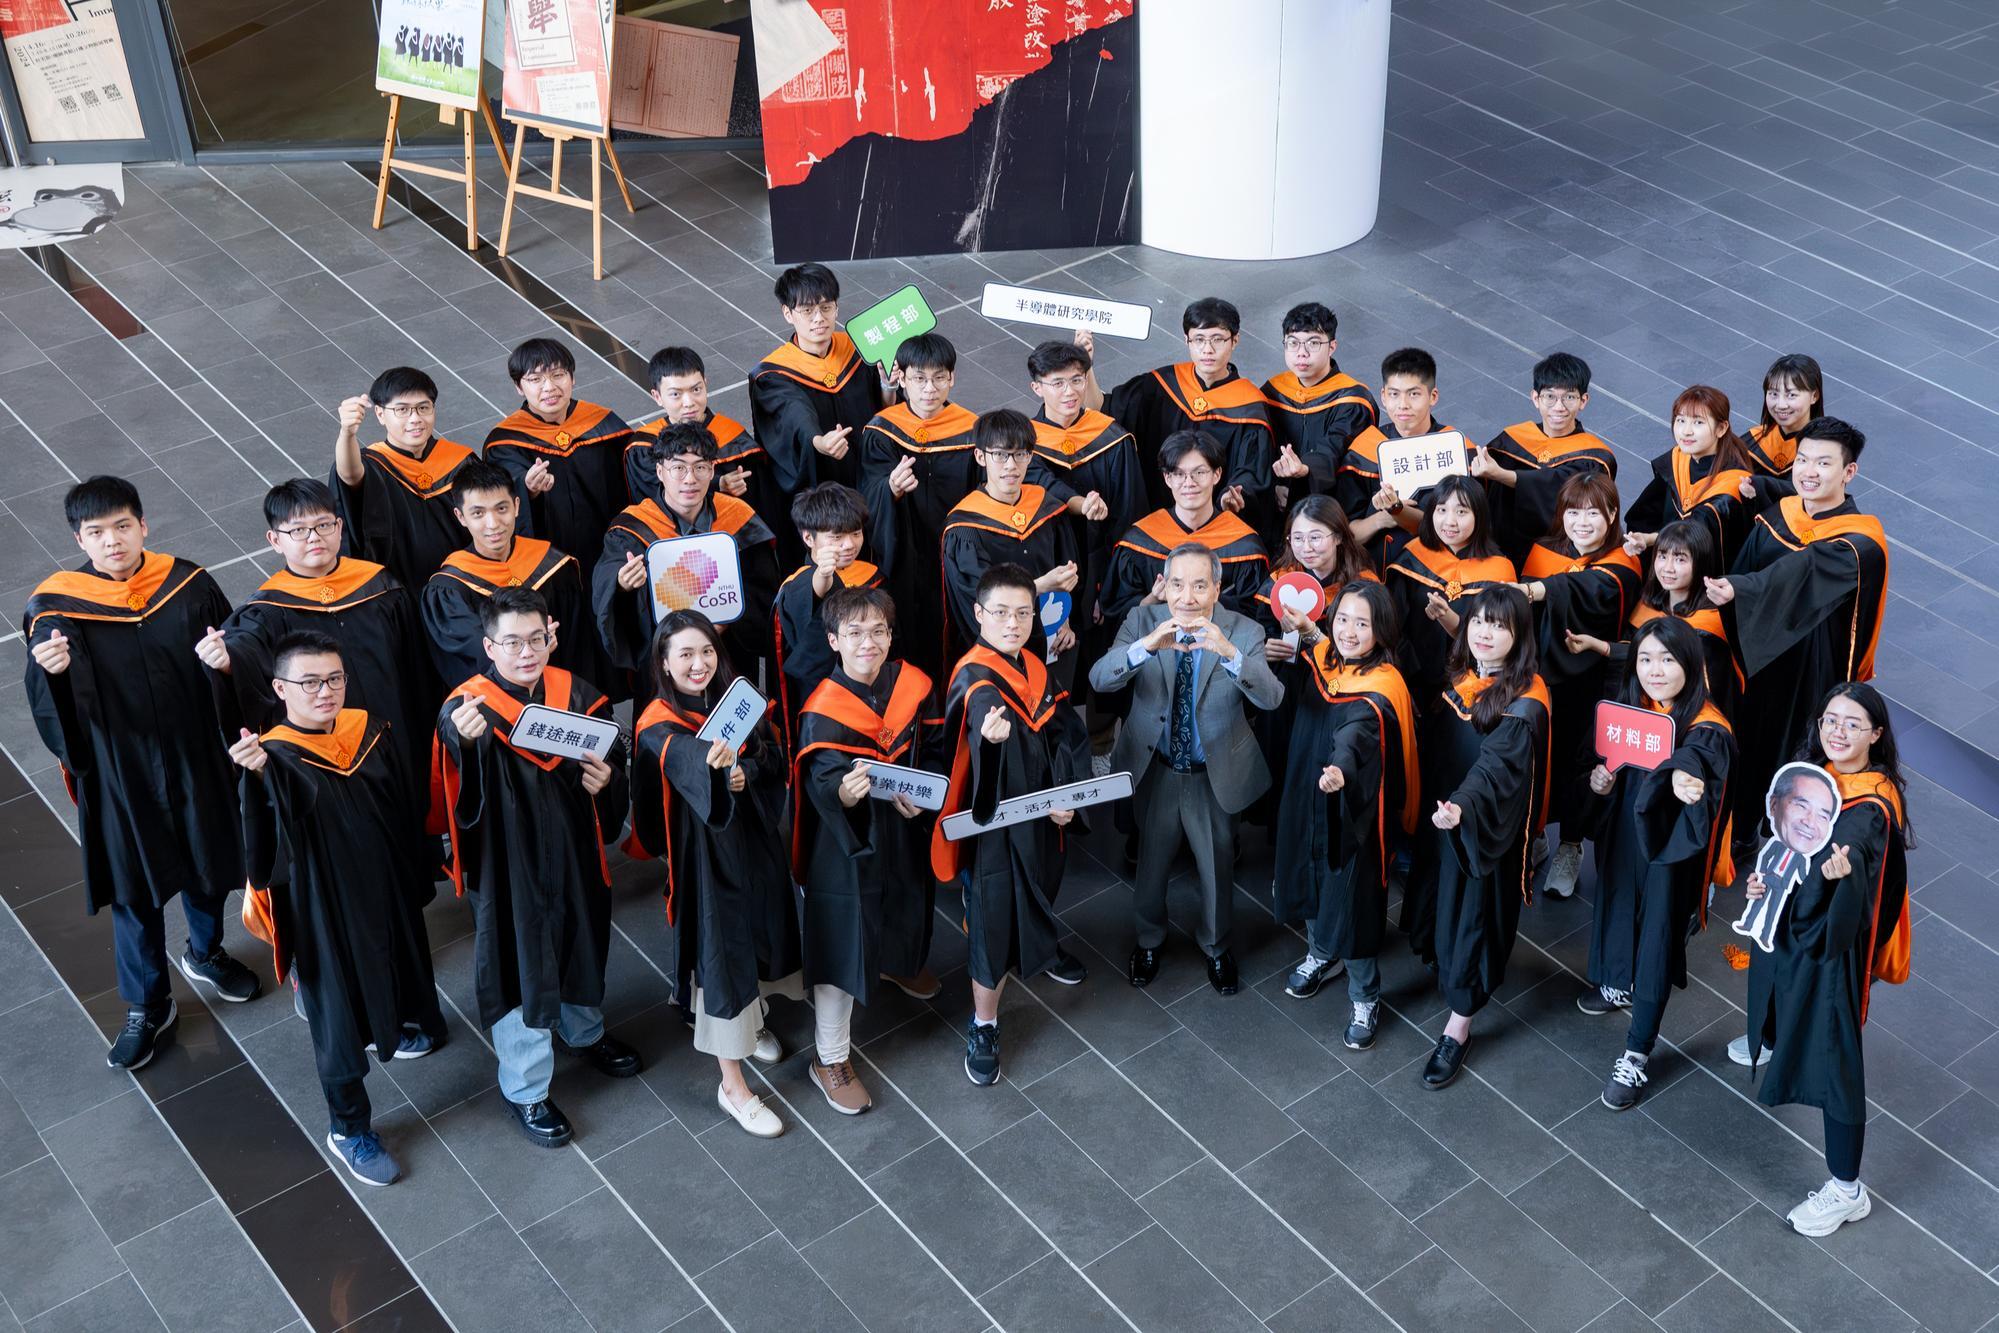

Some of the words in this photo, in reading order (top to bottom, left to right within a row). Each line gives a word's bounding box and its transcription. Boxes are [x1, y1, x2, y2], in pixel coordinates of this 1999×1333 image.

[863, 303, 921, 346] 製程部
[1016, 298, 1113, 325] 半導體研究學院
[1392, 449, 1454, 475] 設計部
[698, 591, 738, 608] CoSR
[718, 584, 735, 592] NTHU
[720, 698, 751, 741] 件部
[526, 721, 600, 751] 錢途無量
[1606, 722, 1661, 754] 材料部
